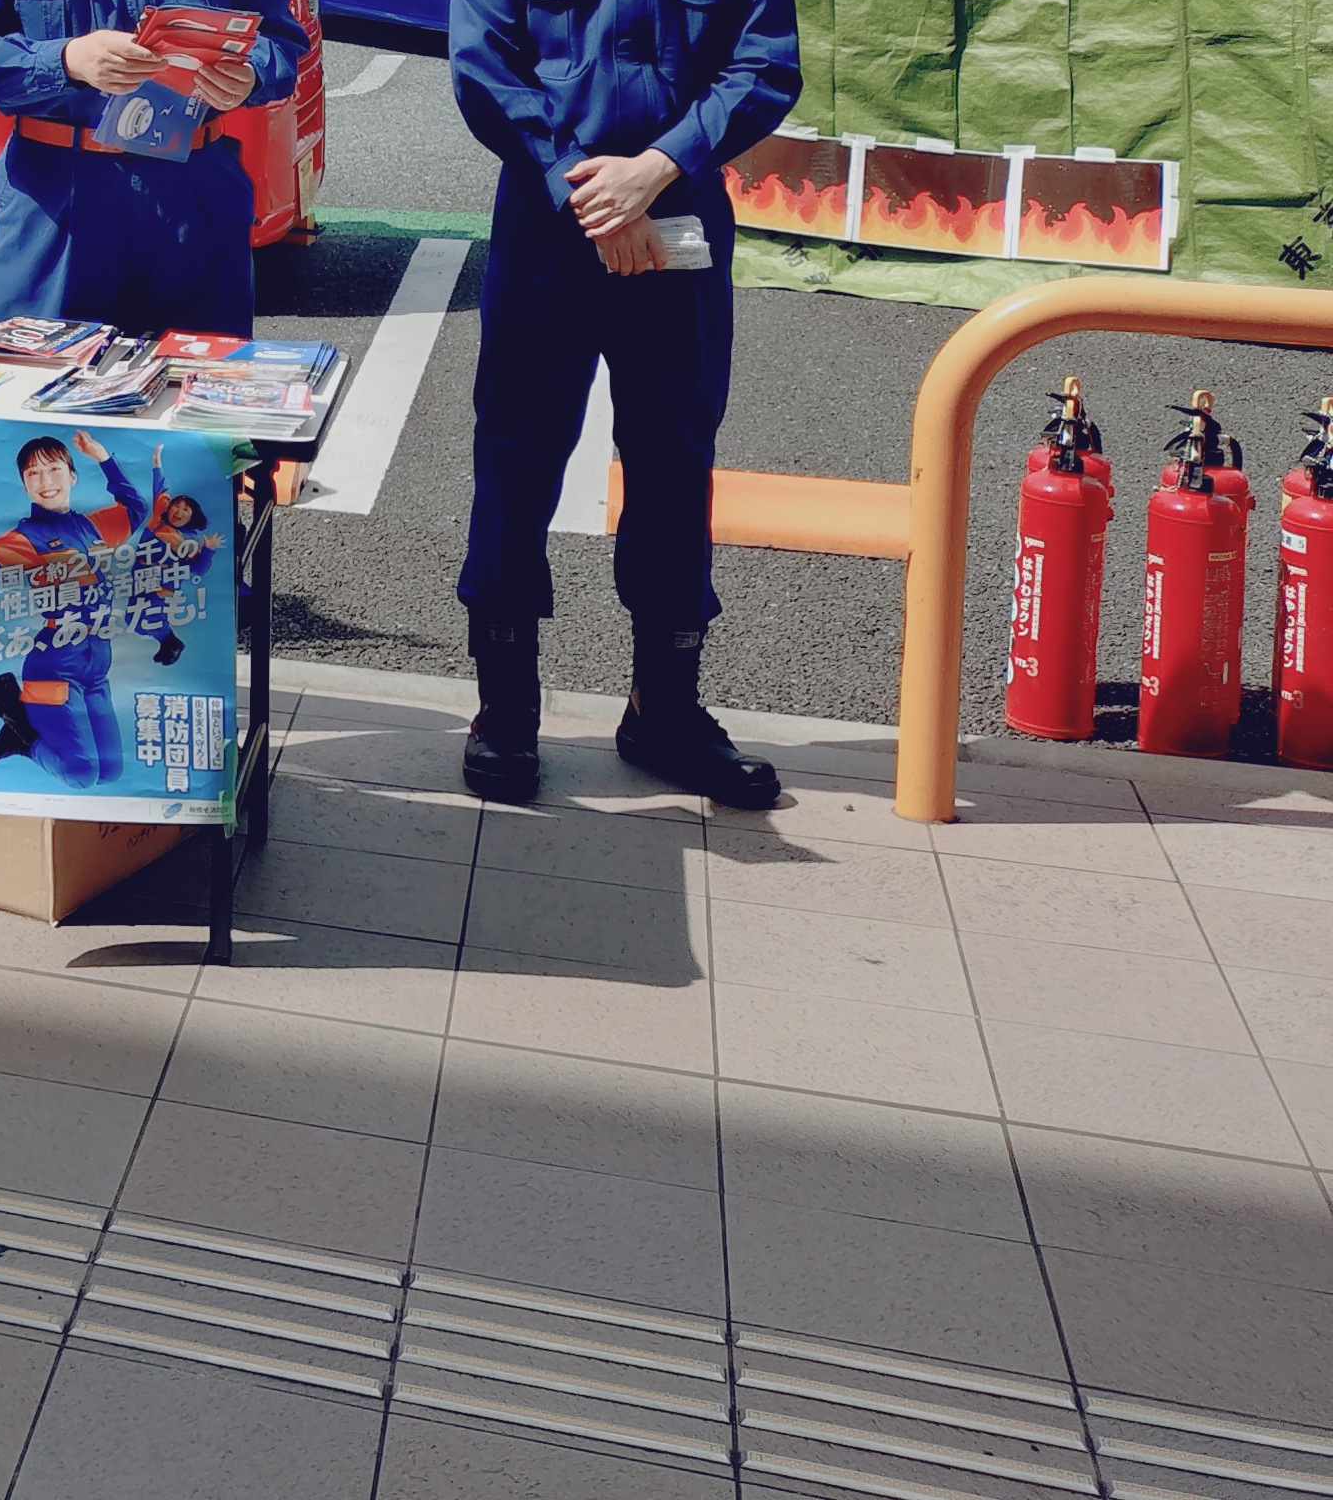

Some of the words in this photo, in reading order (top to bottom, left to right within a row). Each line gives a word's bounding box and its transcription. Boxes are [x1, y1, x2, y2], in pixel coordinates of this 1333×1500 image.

[136, 693, 162, 767] 募集中
[163, 694, 190, 793] 消防団員
